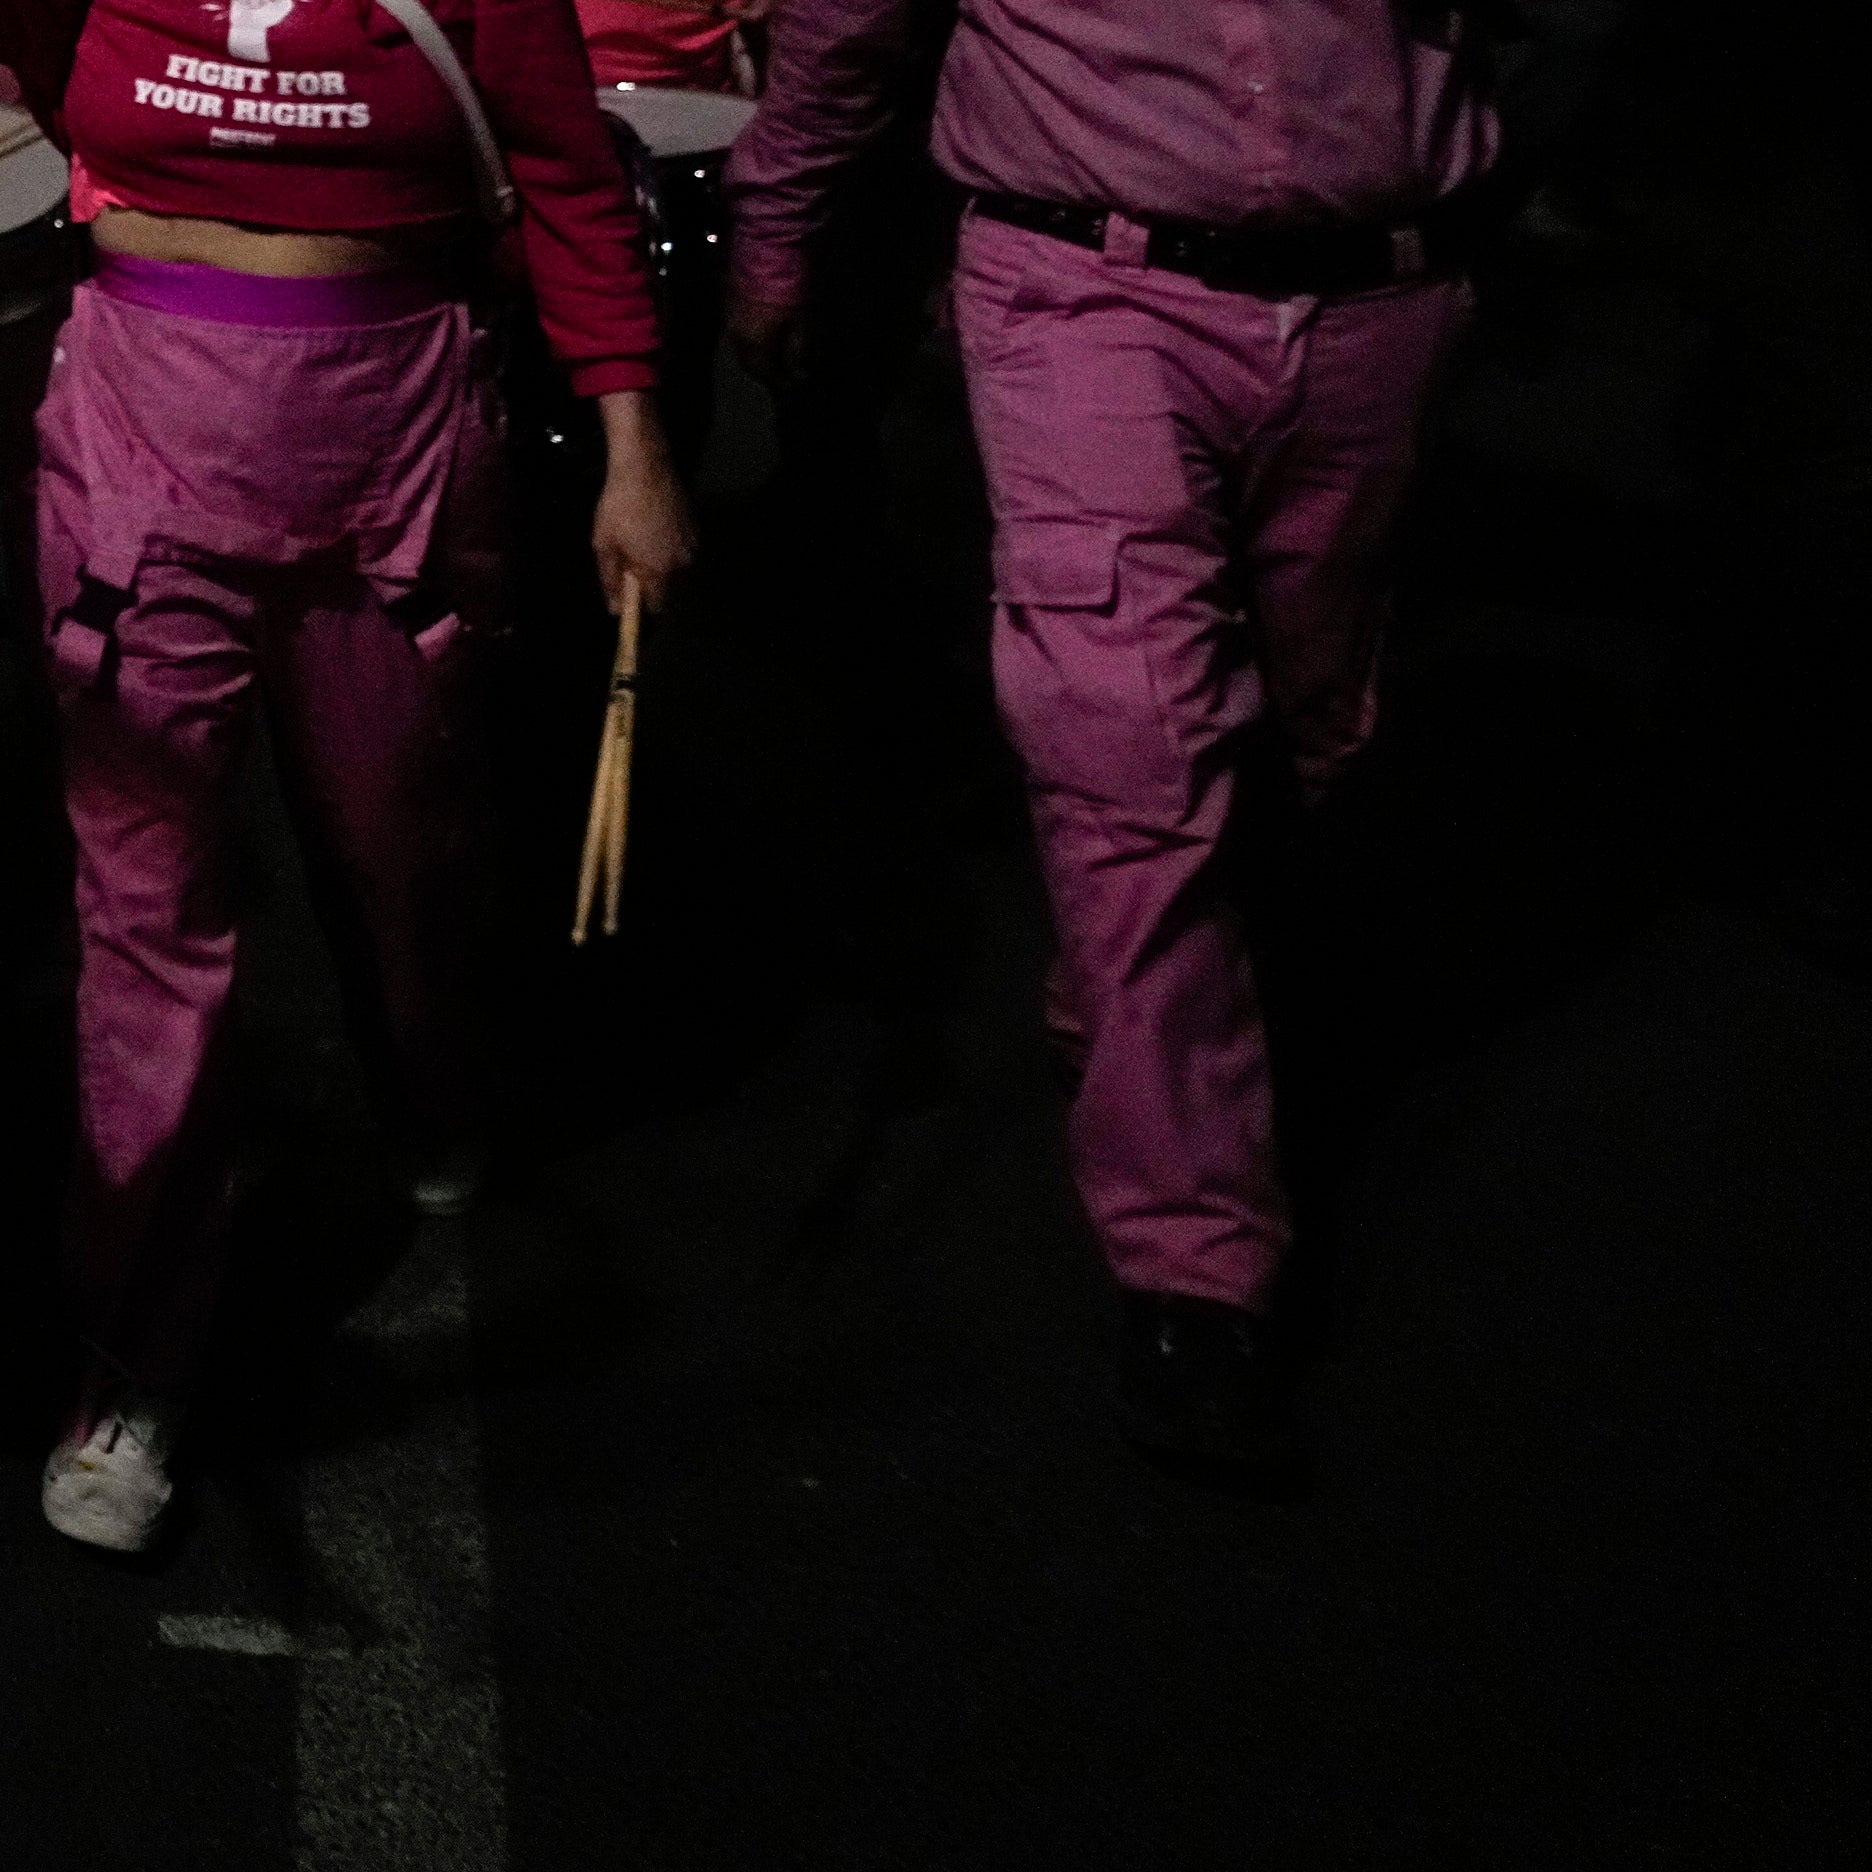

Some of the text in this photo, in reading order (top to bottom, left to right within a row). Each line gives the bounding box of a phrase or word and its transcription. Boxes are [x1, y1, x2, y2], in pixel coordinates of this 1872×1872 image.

[166, 53, 347, 96] FIGHT FOR
[133, 77, 372, 130] YOUR RIGHTS
